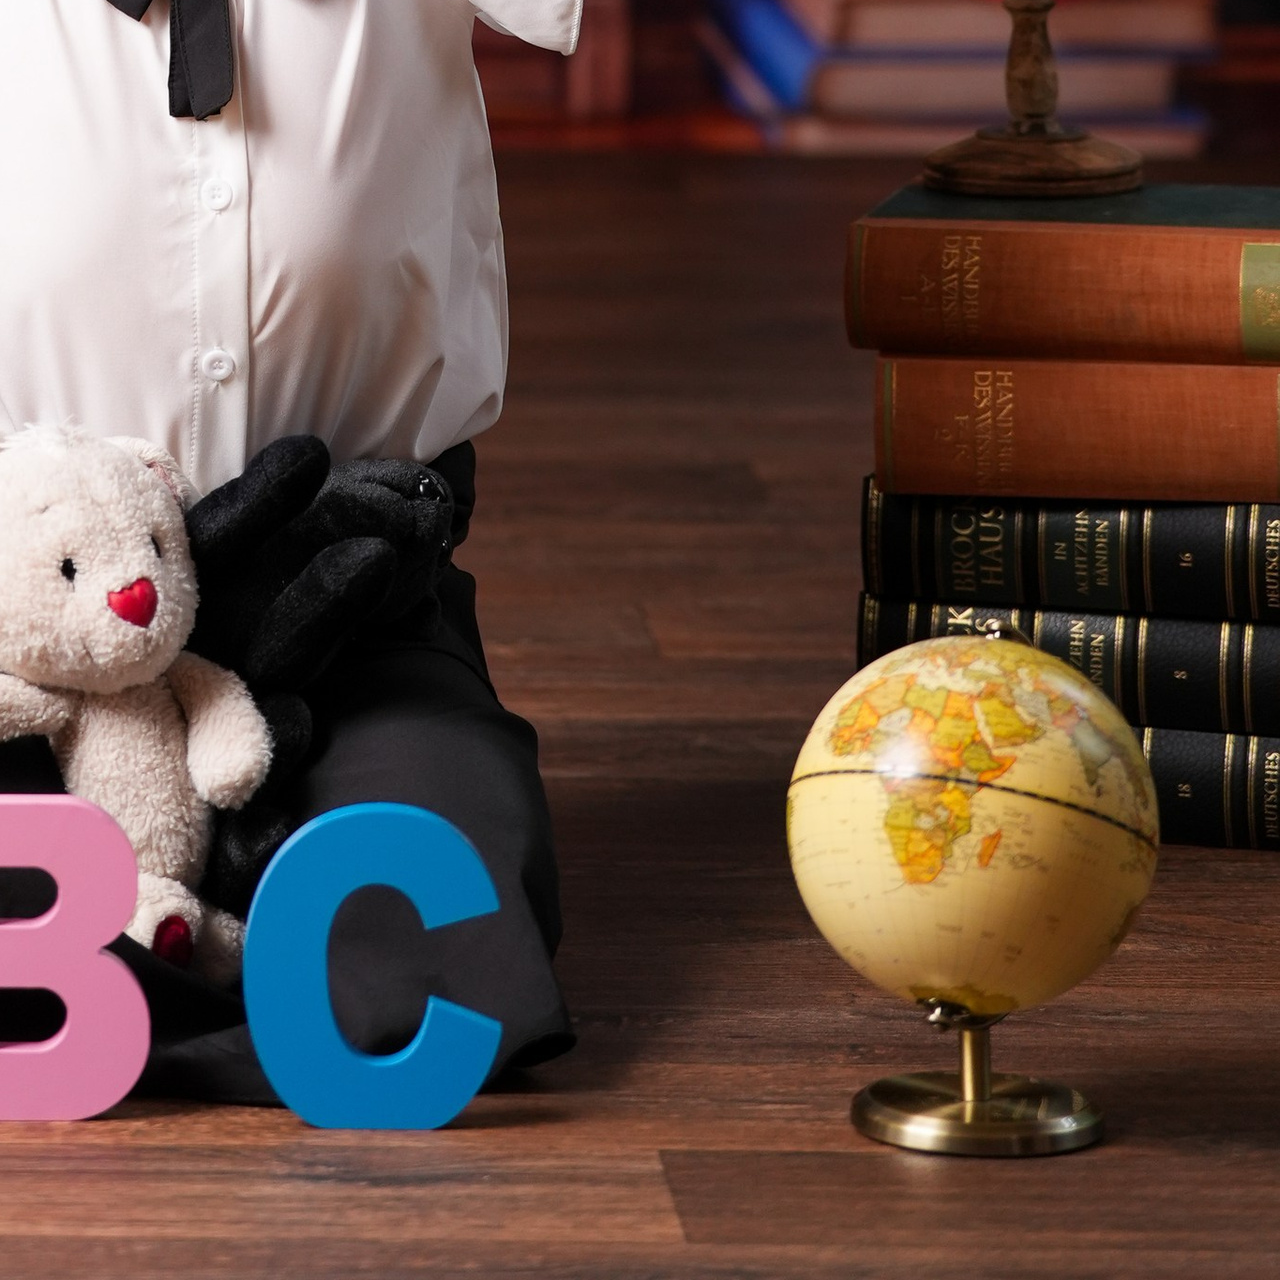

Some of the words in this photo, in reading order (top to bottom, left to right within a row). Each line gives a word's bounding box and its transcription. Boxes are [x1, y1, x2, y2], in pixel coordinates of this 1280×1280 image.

[973, 370, 992, 409] DES
[977, 505, 1006, 587] HAUS
[1053, 541, 1068, 561] IN
[1074, 507, 1091, 596] ACHTZEHN
[1178, 552, 1193, 569] 16
[1265, 518, 1280, 610] DEUTSCHES
[1173, 670, 1188, 681] 8
[1177, 783, 1192, 799] 18
[1263, 751, 1280, 839] DEUTSCHES
